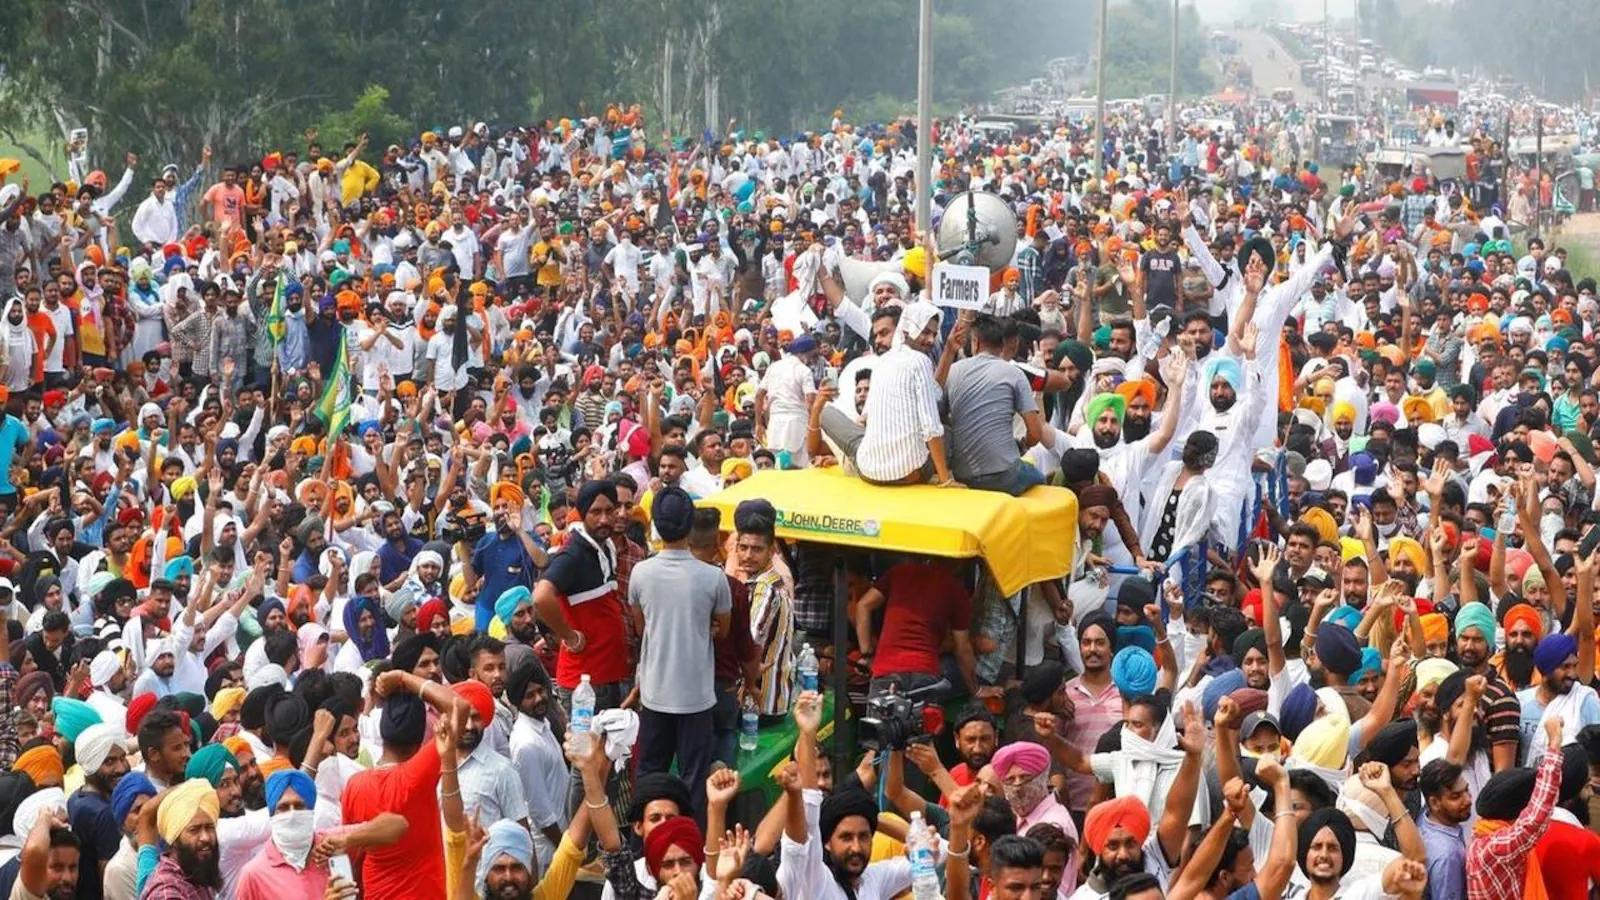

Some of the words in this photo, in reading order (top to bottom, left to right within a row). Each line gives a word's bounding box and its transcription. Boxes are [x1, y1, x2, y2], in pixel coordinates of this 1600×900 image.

[940, 272, 979, 302] Farmers
[786, 511, 819, 526] JOHN
[822, 515, 861, 531] DEERE
